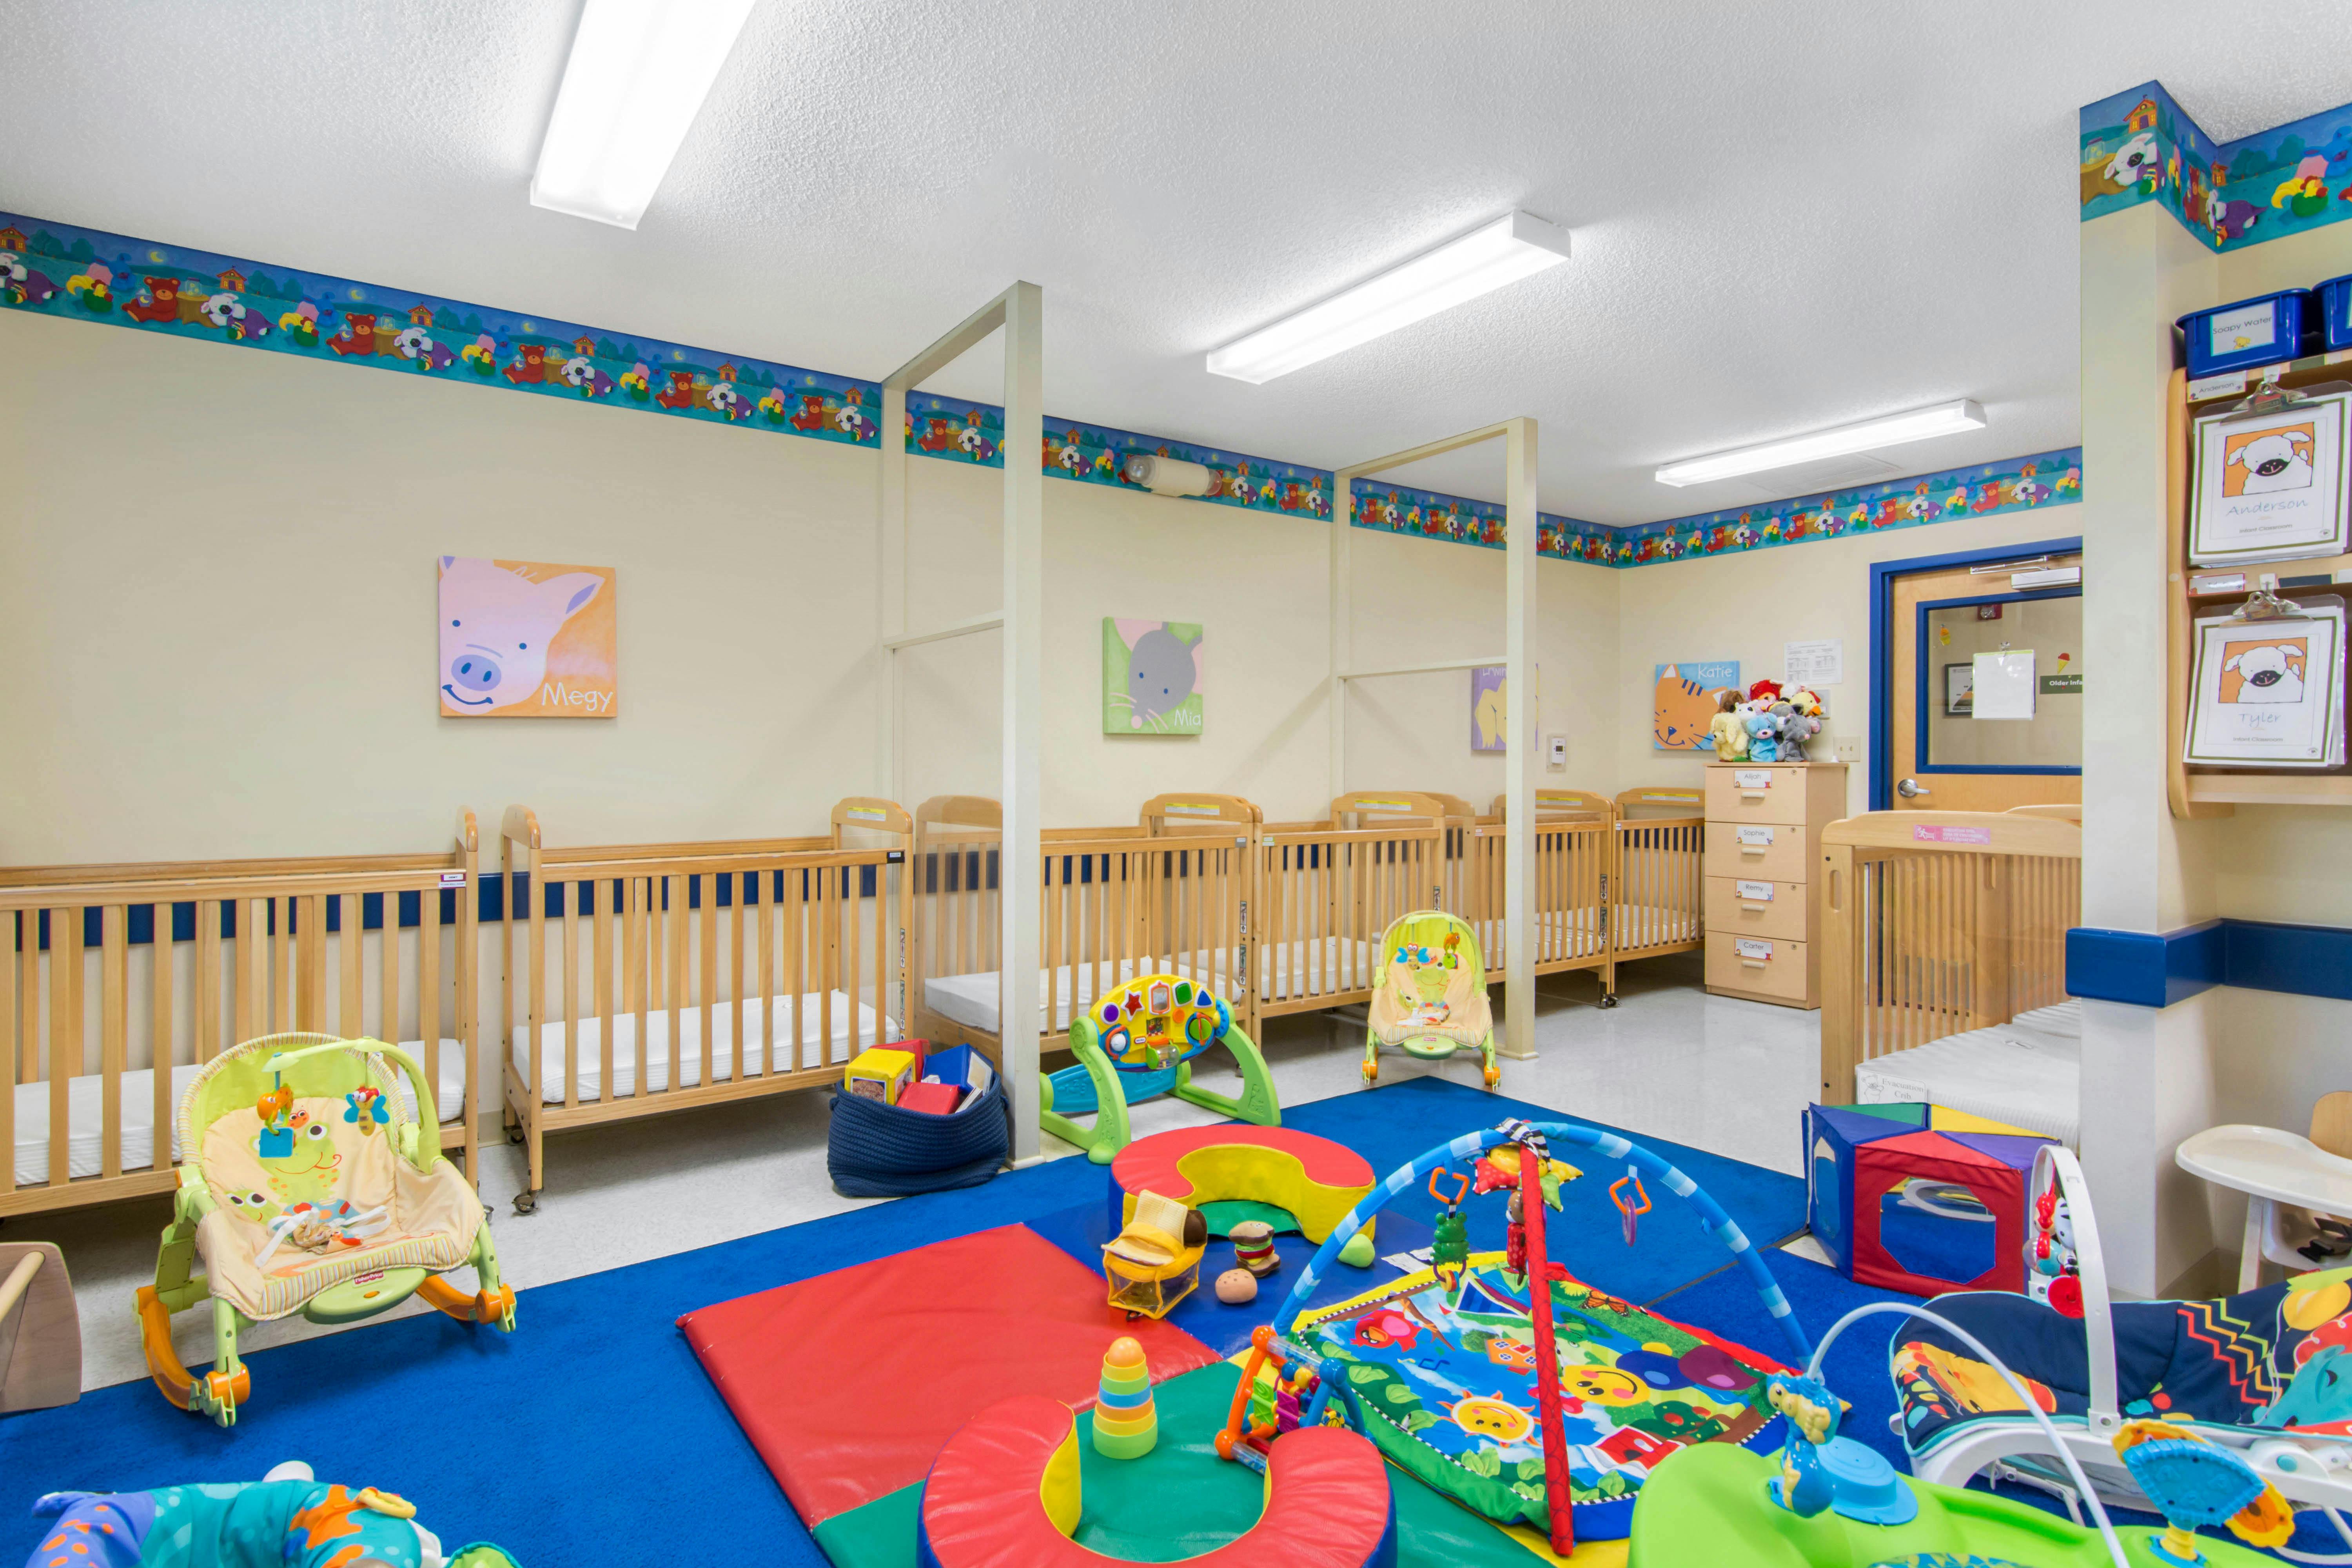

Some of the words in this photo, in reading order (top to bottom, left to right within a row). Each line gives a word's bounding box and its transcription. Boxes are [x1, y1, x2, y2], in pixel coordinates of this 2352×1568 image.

[2213, 324, 2241, 334] Soapy
[2244, 317, 2271, 327] Water
[2199, 383, 2234, 393] Anderson
[2225, 500, 2308, 517] Anderson
[1698, 664, 1733, 680] Katie
[541, 682, 613, 712] Megy
[1174, 708, 1201, 726] Mia
[2238, 711, 2281, 728] Tyler
[1882, 1078, 1924, 1093] Evacuation
[1894, 1091, 1911, 1100] Crib
